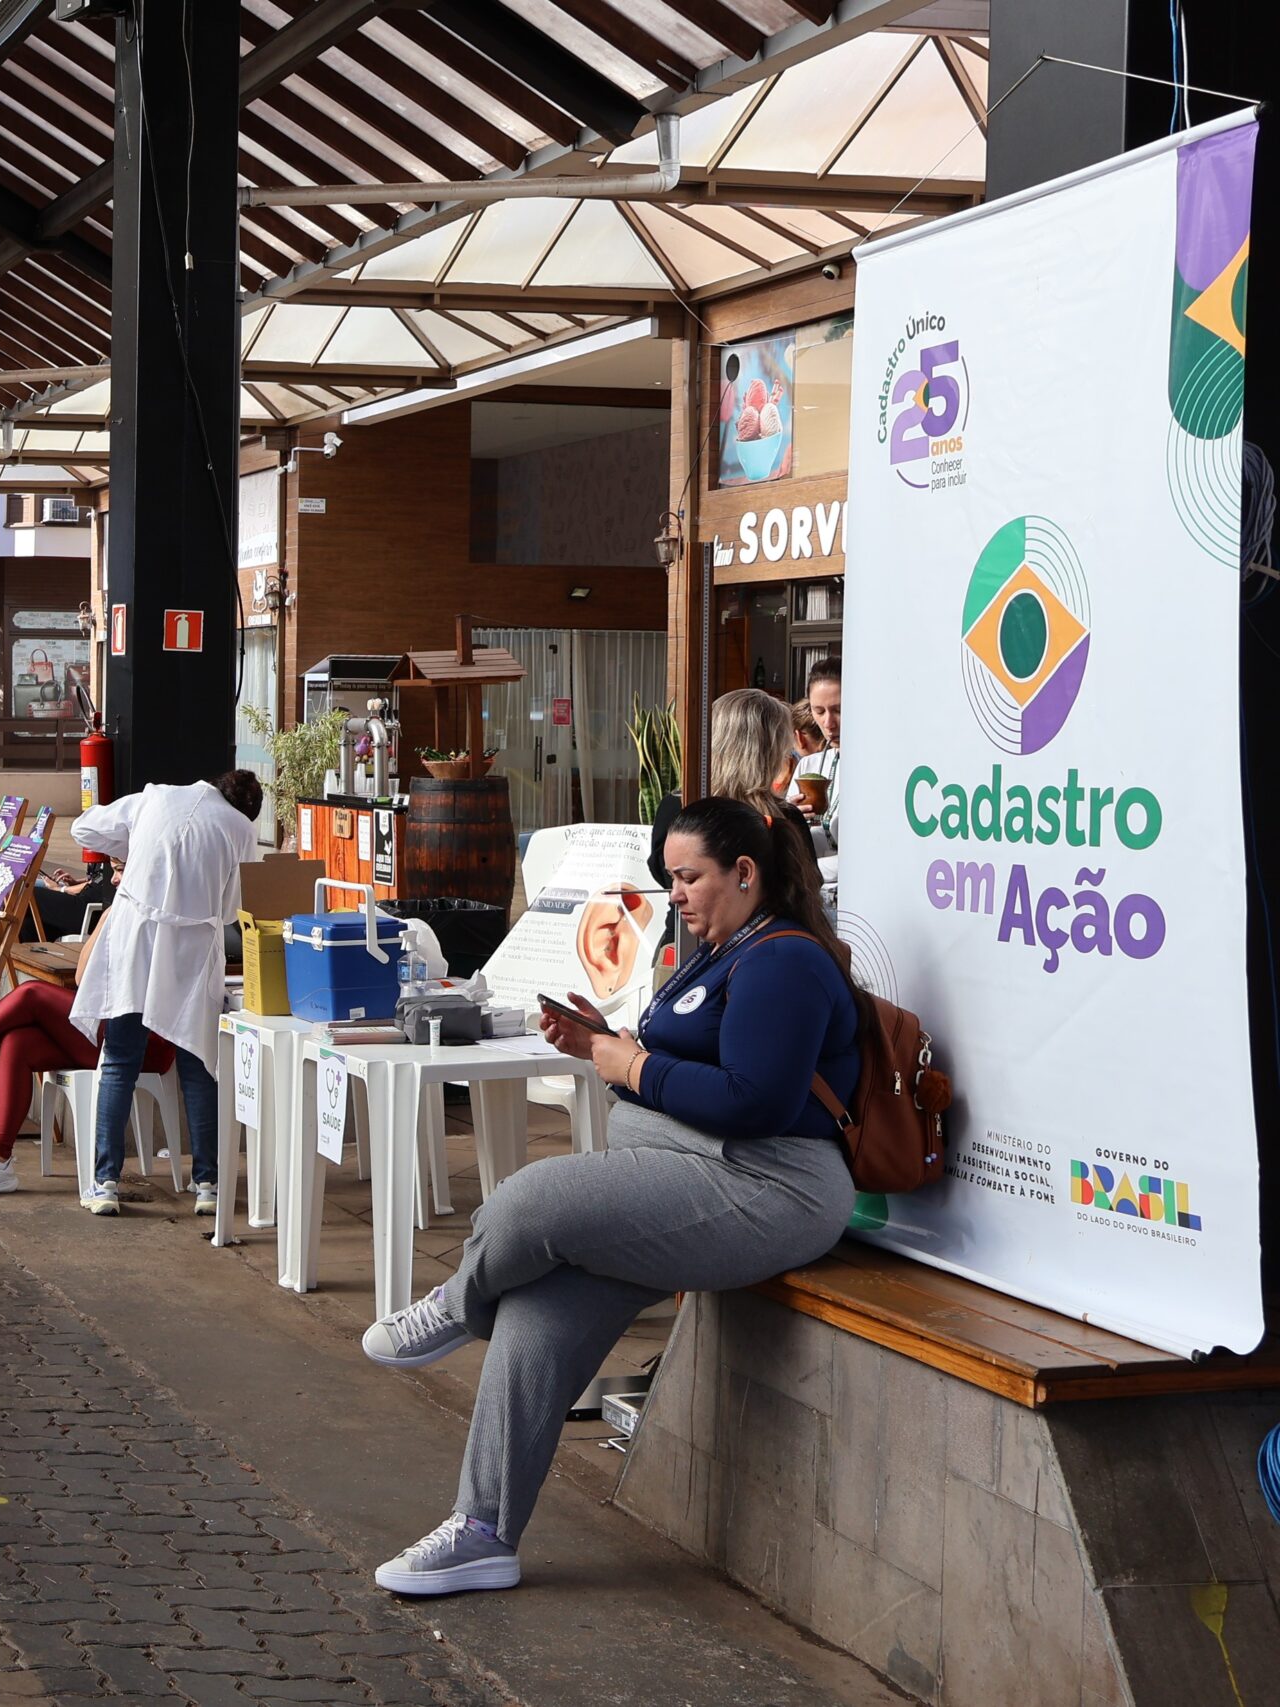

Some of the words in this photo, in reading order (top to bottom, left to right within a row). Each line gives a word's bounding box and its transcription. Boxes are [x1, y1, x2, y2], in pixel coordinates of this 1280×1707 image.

[877, 338, 905, 444] Cadastro
[906, 311, 945, 340] Único
[890, 340, 959, 465] 25
[931, 436, 963, 456] anos
[931, 458, 963, 475] Conhecer
[931, 476, 946, 494] para
[947, 470, 967, 487] incluir
[904, 764, 1162, 850] Cadastro
[926, 859, 995, 914] em
[997, 864, 1166, 973] Ação
[238, 1081, 255, 1100] SAÚDE
[322, 1111, 342, 1132] SAÚDE
[972, 1141, 1051, 1171] DESENVOLVIMENTO
[986, 1130, 1033, 1151] MINISTÉRIO
[1037, 1143, 1051, 1155] DO
[956, 1153, 961, 1162] E
[962, 1154, 1011, 1178] ASSISTÊNCIA
[1014, 1170, 1054, 1190] SOCIAL,
[1095, 1148, 1148, 1167] GOVERNO
[1154, 1159, 1170, 1171] DO
[969, 1173, 975, 1183] E
[976, 1176, 1016, 1195] COMBATE
[1019, 1185, 1026, 1197] À
[1030, 1189, 1056, 1205] FOME
[1071, 1159, 1203, 1232] BRASIL
[1077, 1212, 1088, 1221] DO
[1090, 1215, 1111, 1227] LADO
[1113, 1220, 1125, 1230] DO
[1127, 1224, 1149, 1236] POVO
[1151, 1229, 1197, 1247] BRASILEIRO
